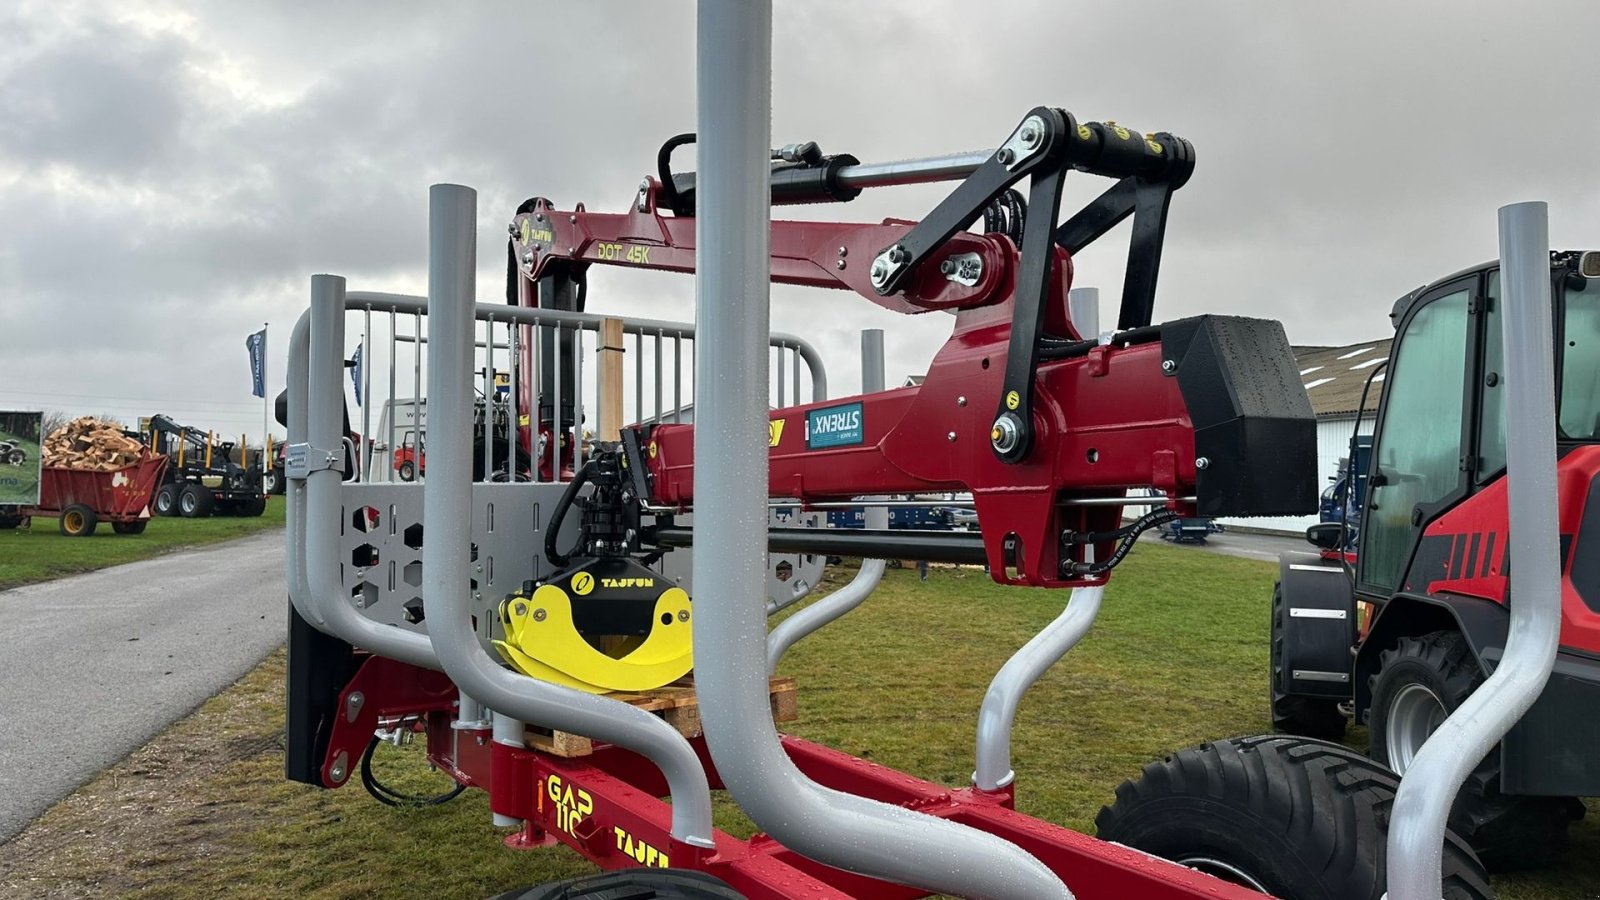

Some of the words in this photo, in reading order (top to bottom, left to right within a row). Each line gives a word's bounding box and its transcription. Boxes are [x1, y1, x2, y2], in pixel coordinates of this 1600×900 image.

[598, 243, 623, 260] DOT
[626, 245, 650, 264] 45K
[815, 410, 860, 434] STRENX
[601, 578, 653, 588] TAJFUN
[547, 774, 593, 816] GAP
